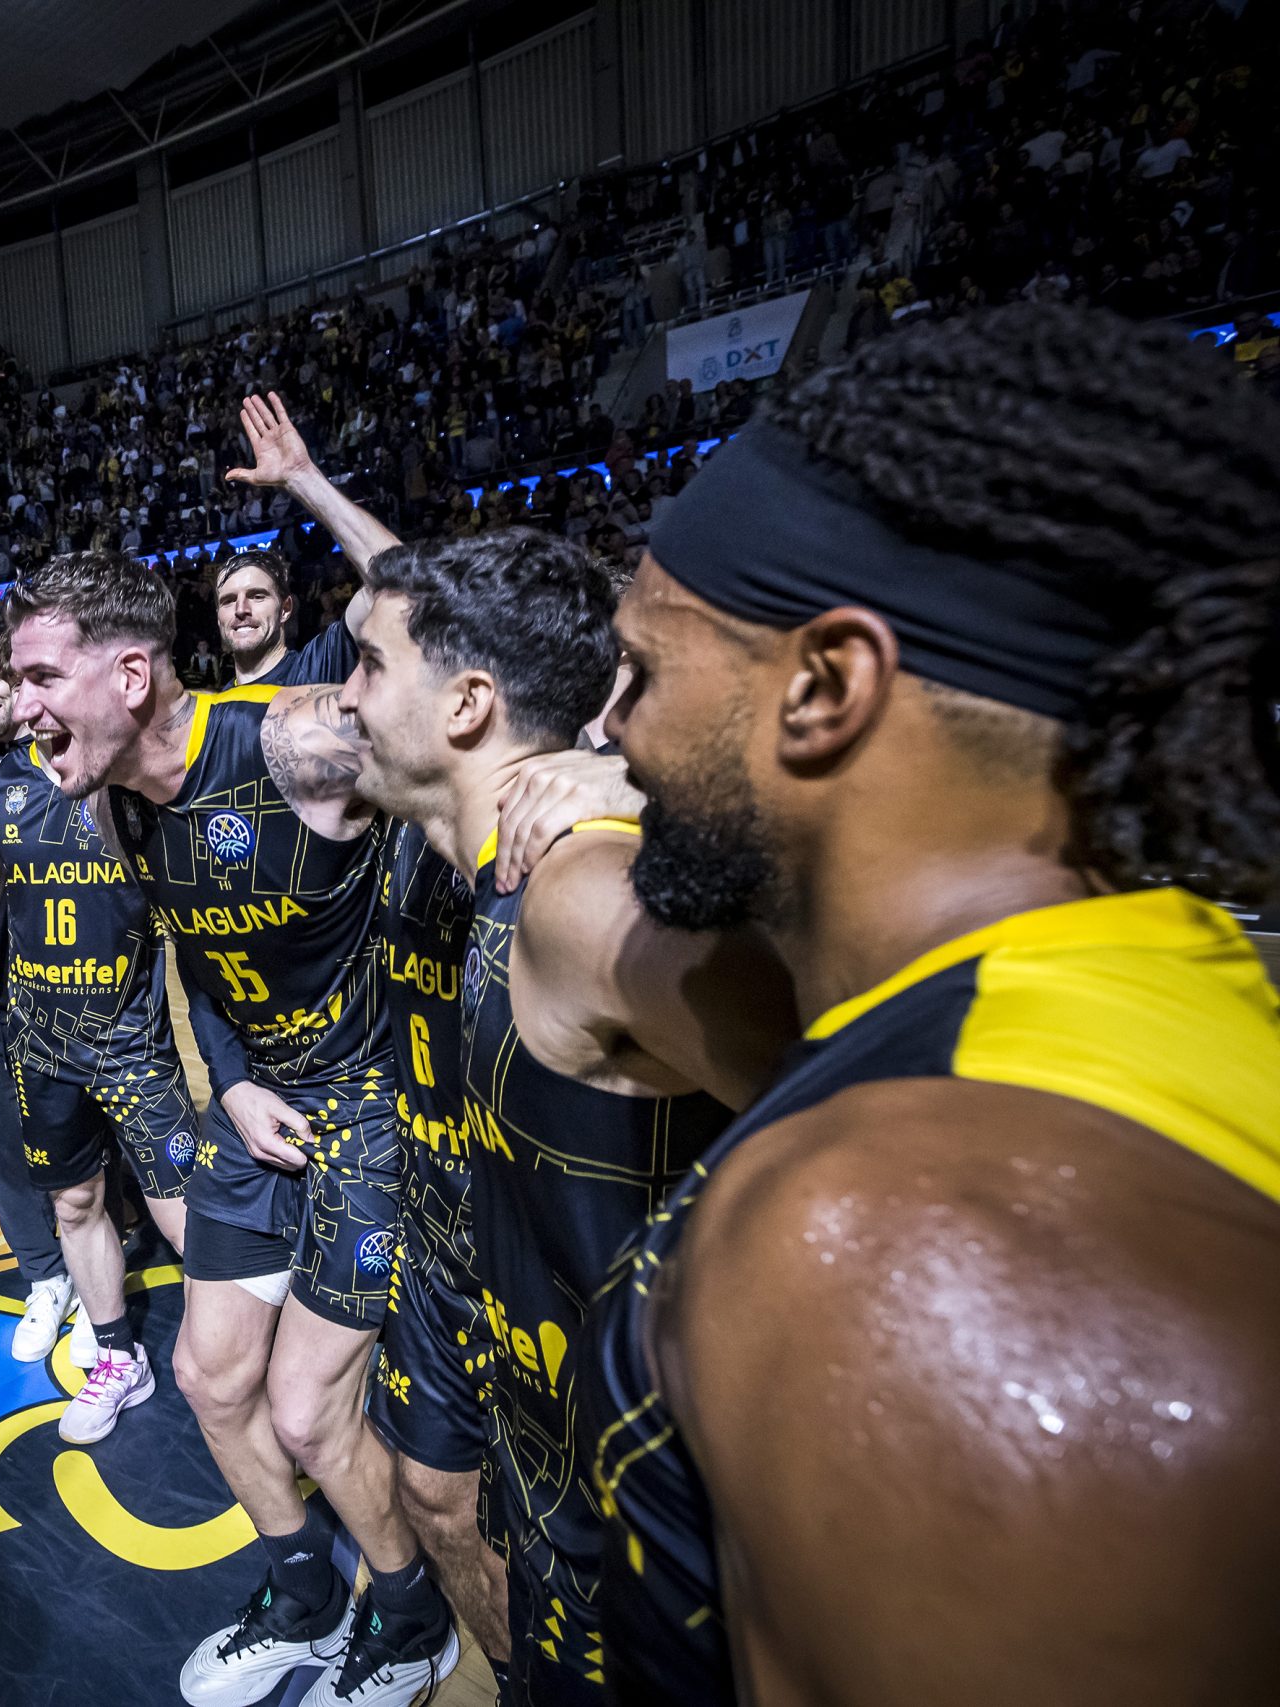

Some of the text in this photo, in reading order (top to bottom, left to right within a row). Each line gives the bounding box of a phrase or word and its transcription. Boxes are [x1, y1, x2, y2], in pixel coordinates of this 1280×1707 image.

[727, 339, 780, 367] DXT
[29, 861, 126, 884] LAGUNA
[44, 898, 77, 945] 16
[171, 896, 309, 936] LAGUNA
[15, 953, 129, 993] tenerife!
[19, 978, 112, 995] awakens emotions
[410, 1013, 436, 1089] 6
